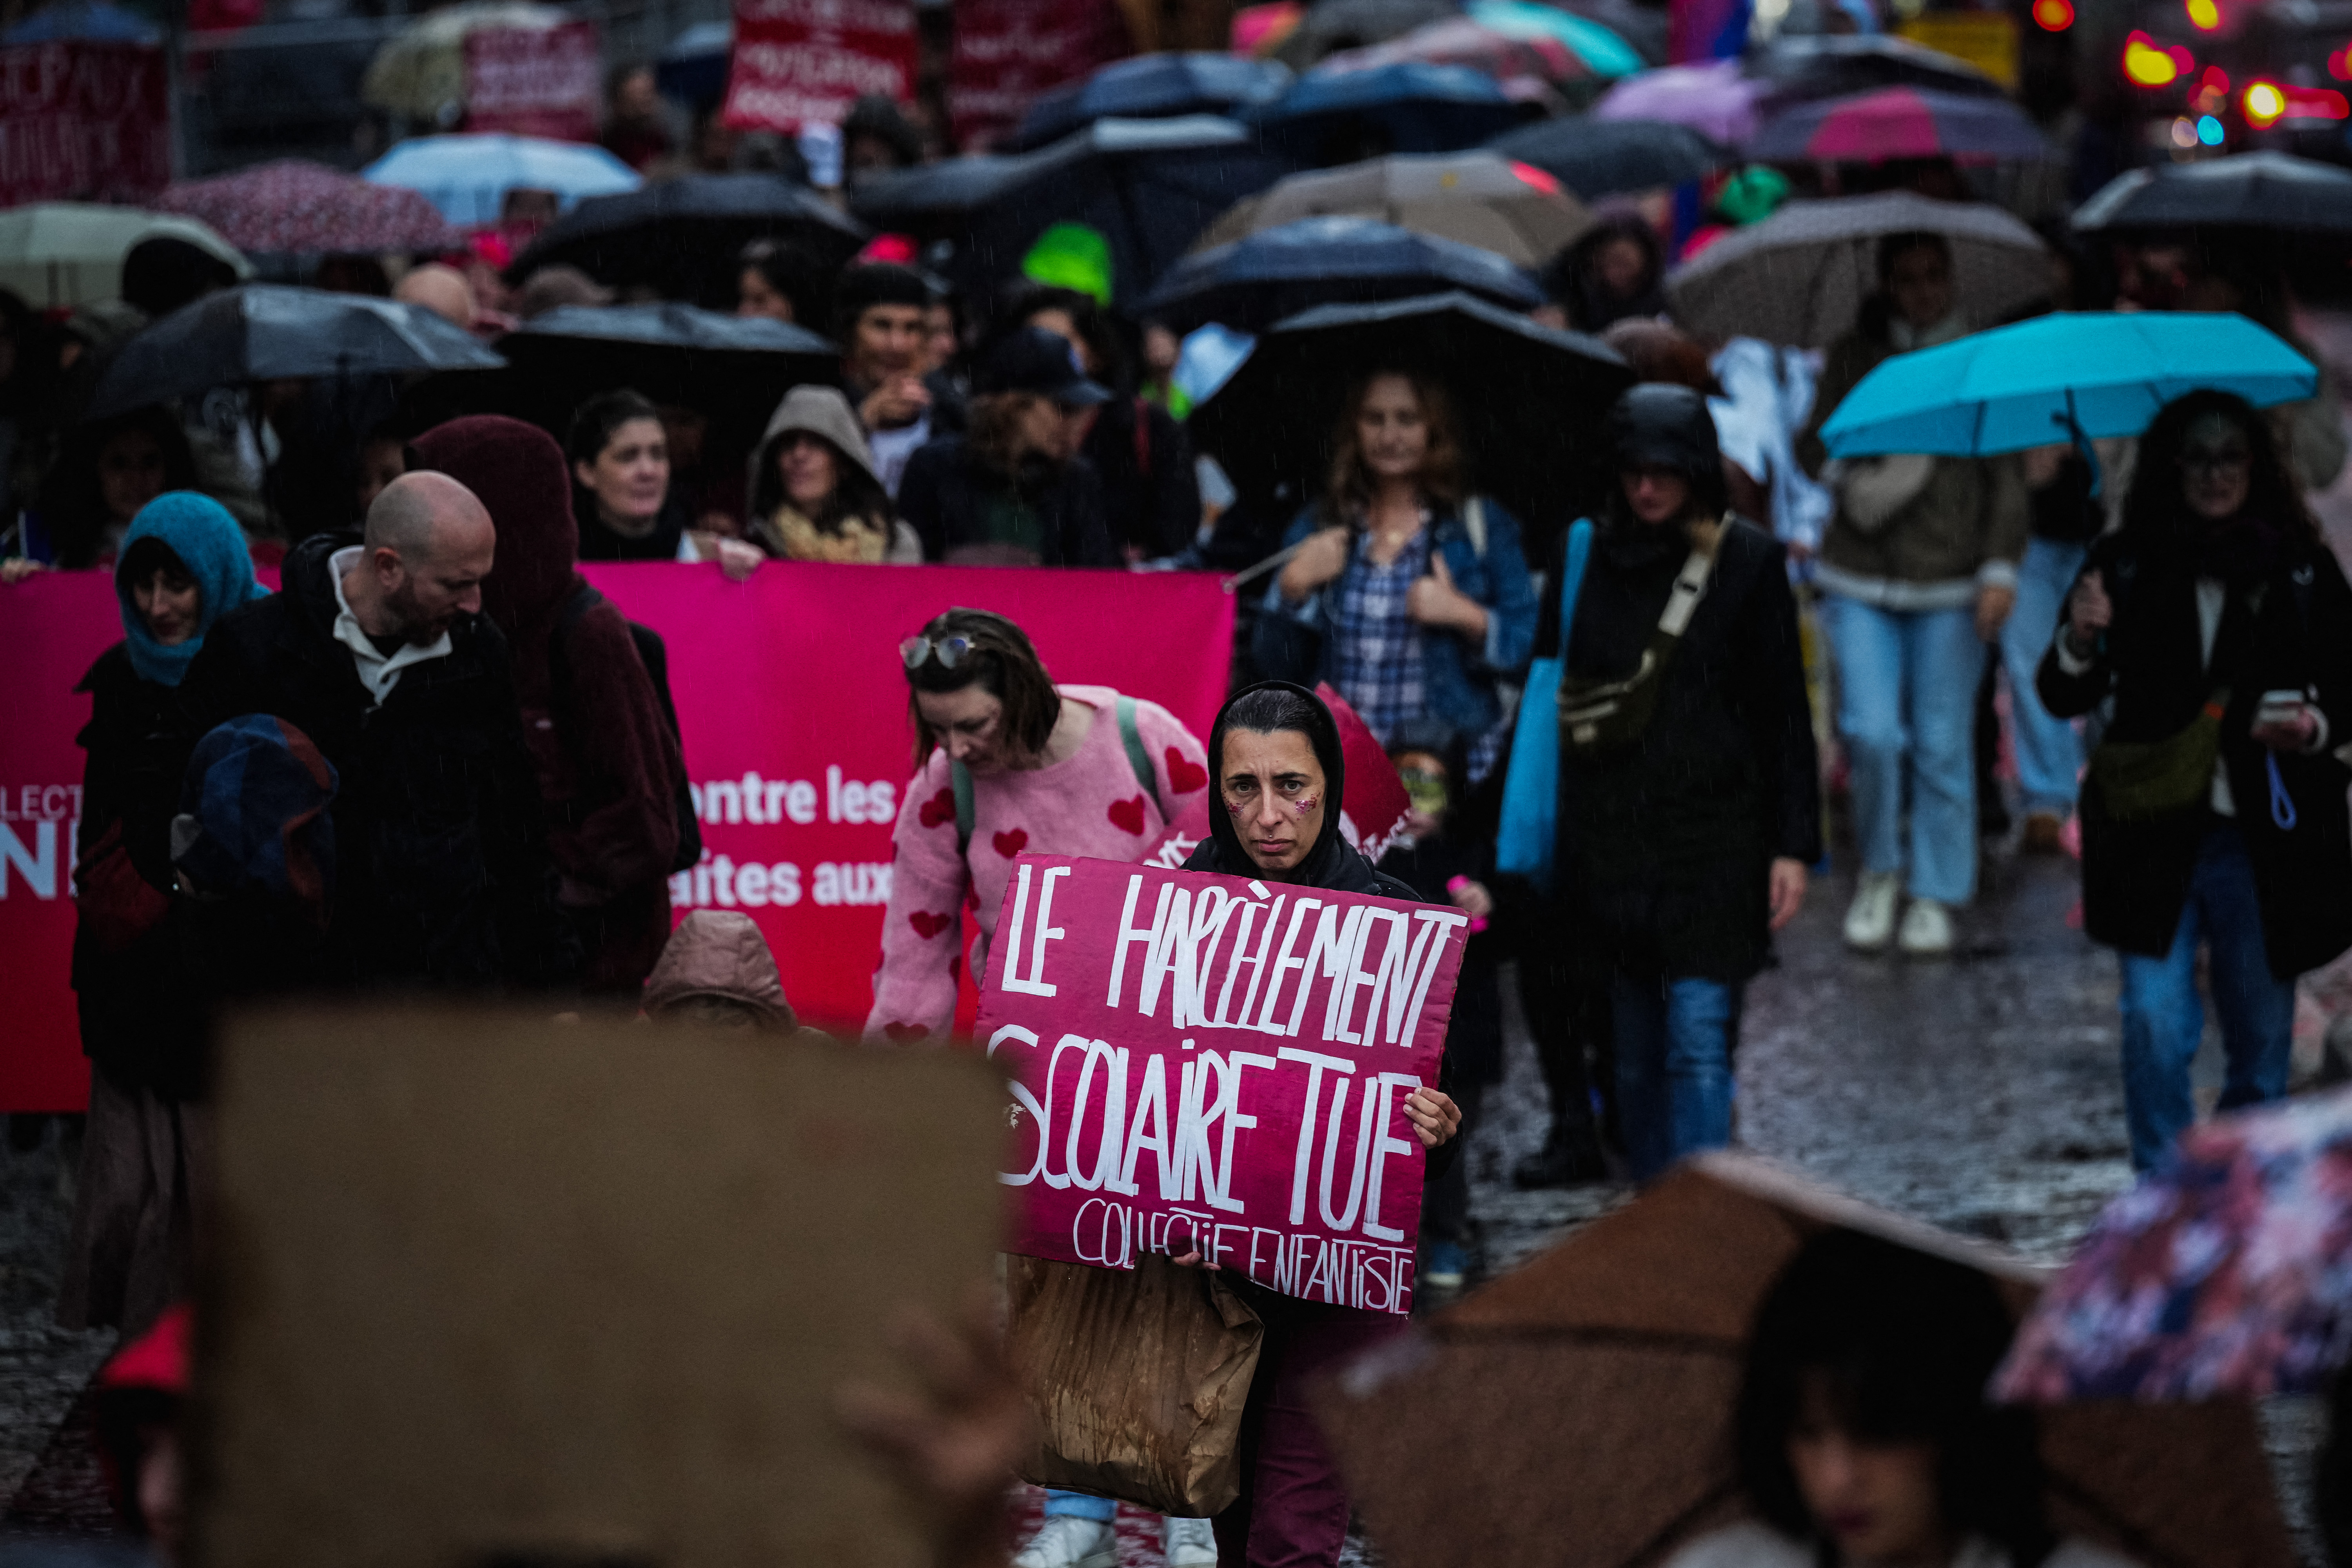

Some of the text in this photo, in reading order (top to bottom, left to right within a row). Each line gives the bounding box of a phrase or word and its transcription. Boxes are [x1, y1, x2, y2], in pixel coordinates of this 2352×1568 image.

[826, 764, 897, 825] les
[811, 861, 894, 907] aux
[1002, 864, 1468, 1048] LE HARCÈLEMENT
[1277, 1046, 1423, 1242] TUE
